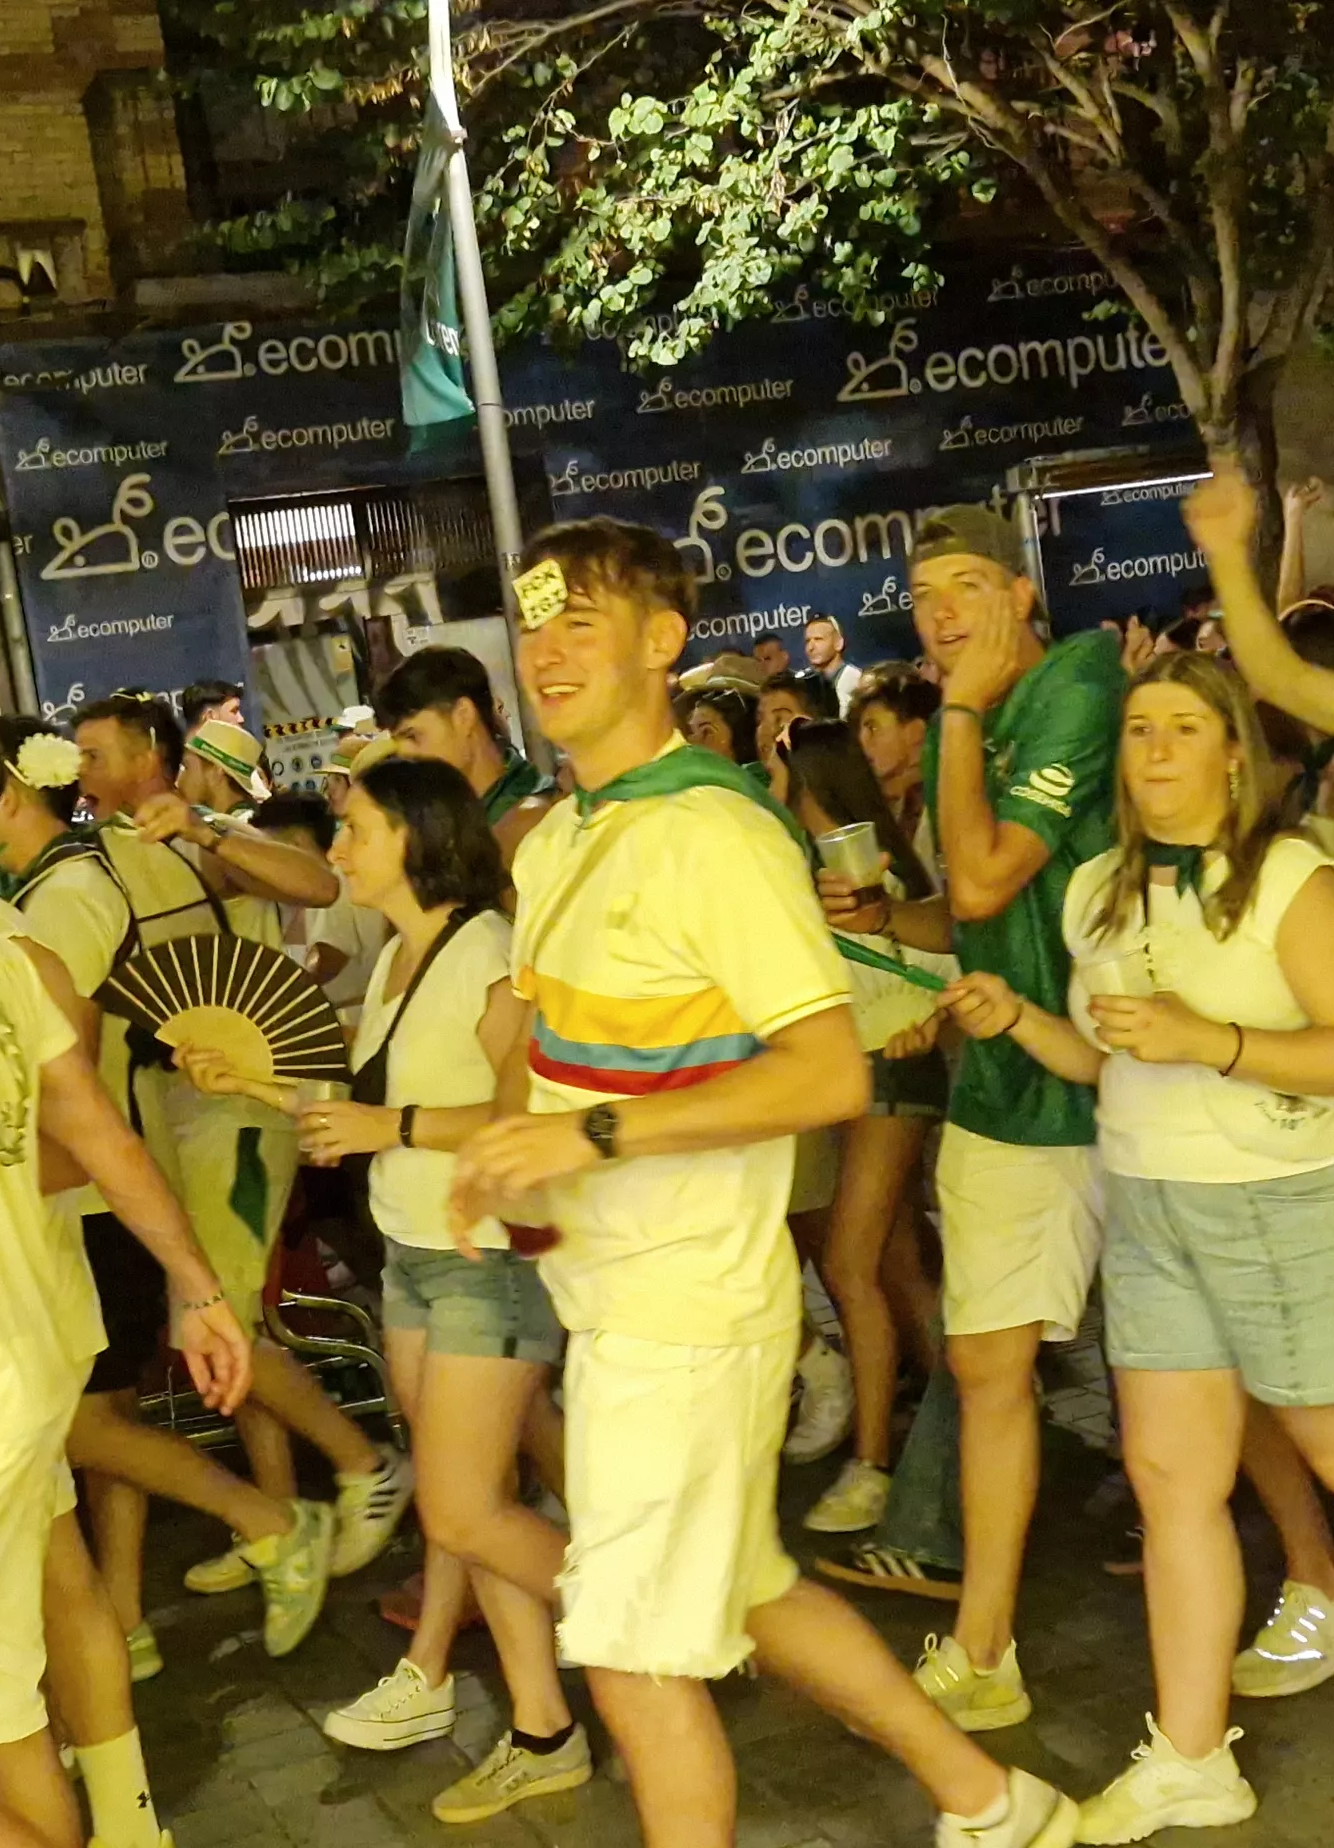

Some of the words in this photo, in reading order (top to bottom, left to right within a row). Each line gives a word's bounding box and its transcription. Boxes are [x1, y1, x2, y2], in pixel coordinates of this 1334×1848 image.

[257, 329, 402, 374] ecom
[675, 379, 793, 408] ecomputer
[261, 417, 395, 450] ecomputer
[975, 415, 1083, 448] ecomputer
[53, 440, 168, 466] ecomputer
[779, 437, 892, 470] ecomputer
[581, 460, 702, 492] ecomputer
[77, 614, 175, 638] ecomputer
